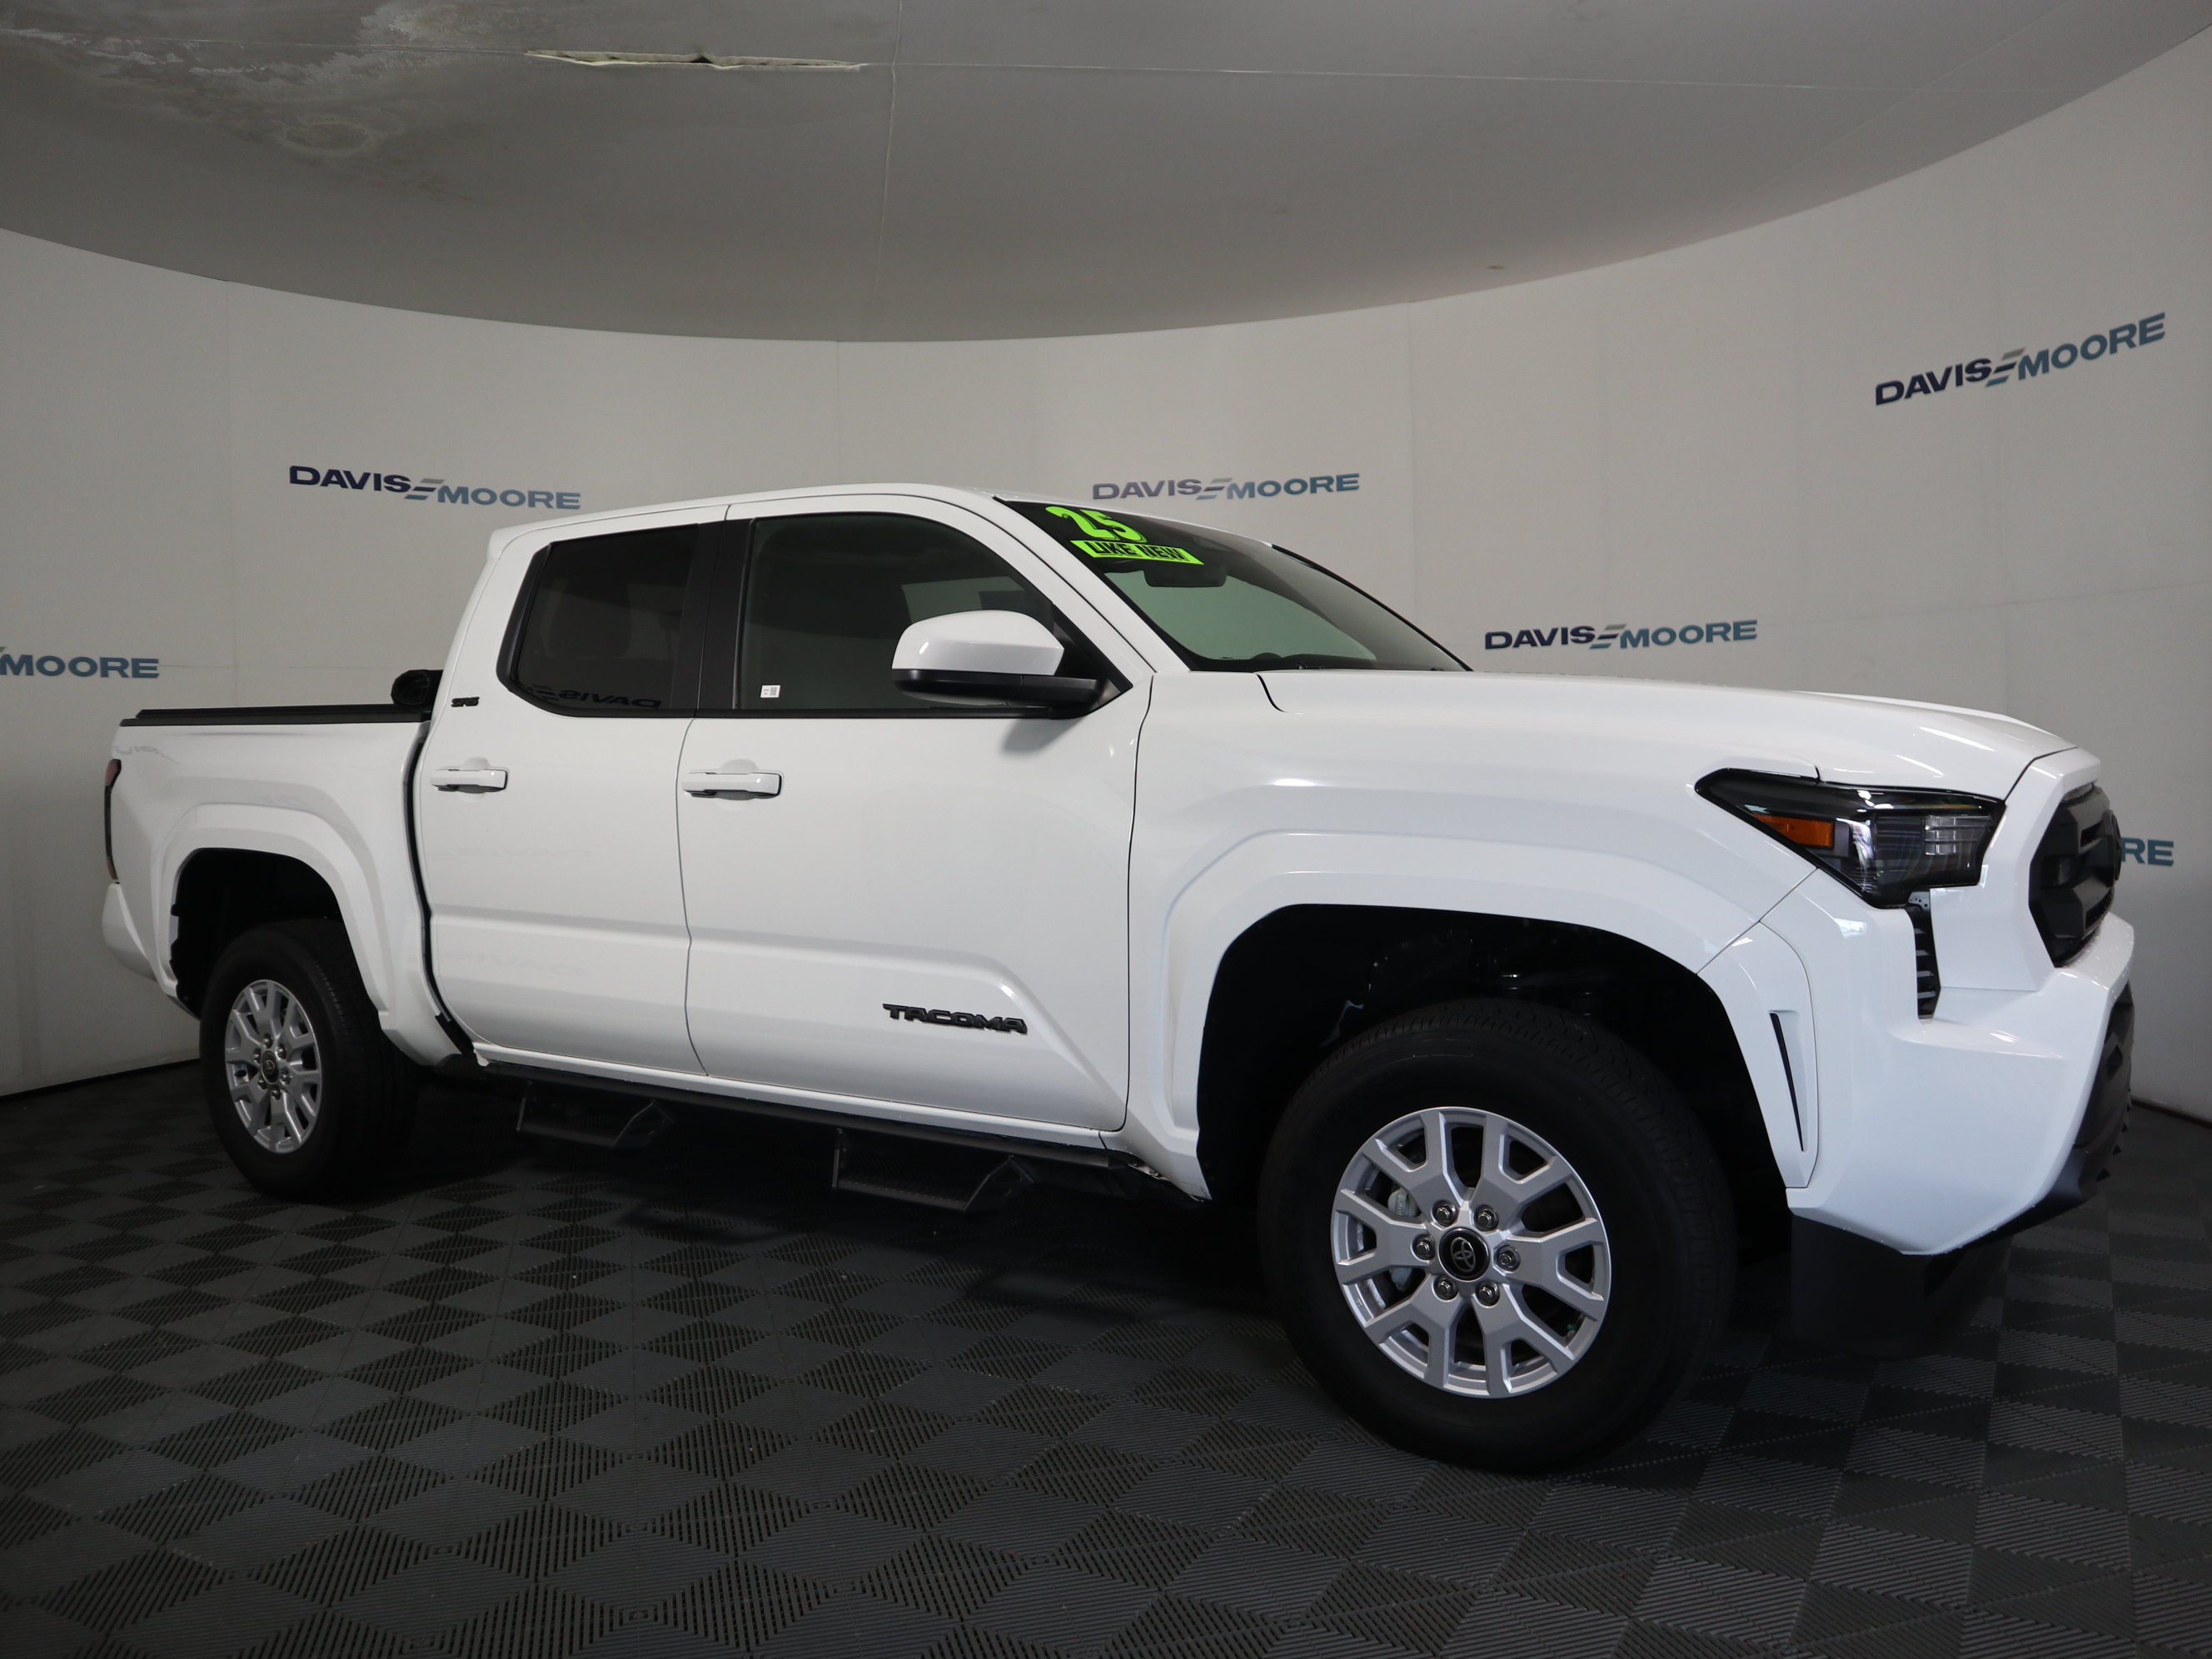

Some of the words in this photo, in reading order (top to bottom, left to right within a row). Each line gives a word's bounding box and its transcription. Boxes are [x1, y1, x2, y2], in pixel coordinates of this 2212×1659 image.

[1876, 358, 1992, 406] DAVIS
[2018, 311, 2165, 381] MOORE
[289, 466, 411, 493] DAVIS
[437, 485, 580, 510] MOORE
[1092, 478, 1202, 500] DAVIS
[1226, 473, 1359, 500] MOORE
[1045, 506, 1148, 543] 25
[1084, 541, 1143, 557] LIKE
[1134, 545, 1192, 562] NEW
[1484, 625, 1596, 650] DAVIS
[1619, 620, 1758, 649] MOORE
[0, 654, 160, 679] MOORE
[882, 1003, 1029, 1035] TACOMA
